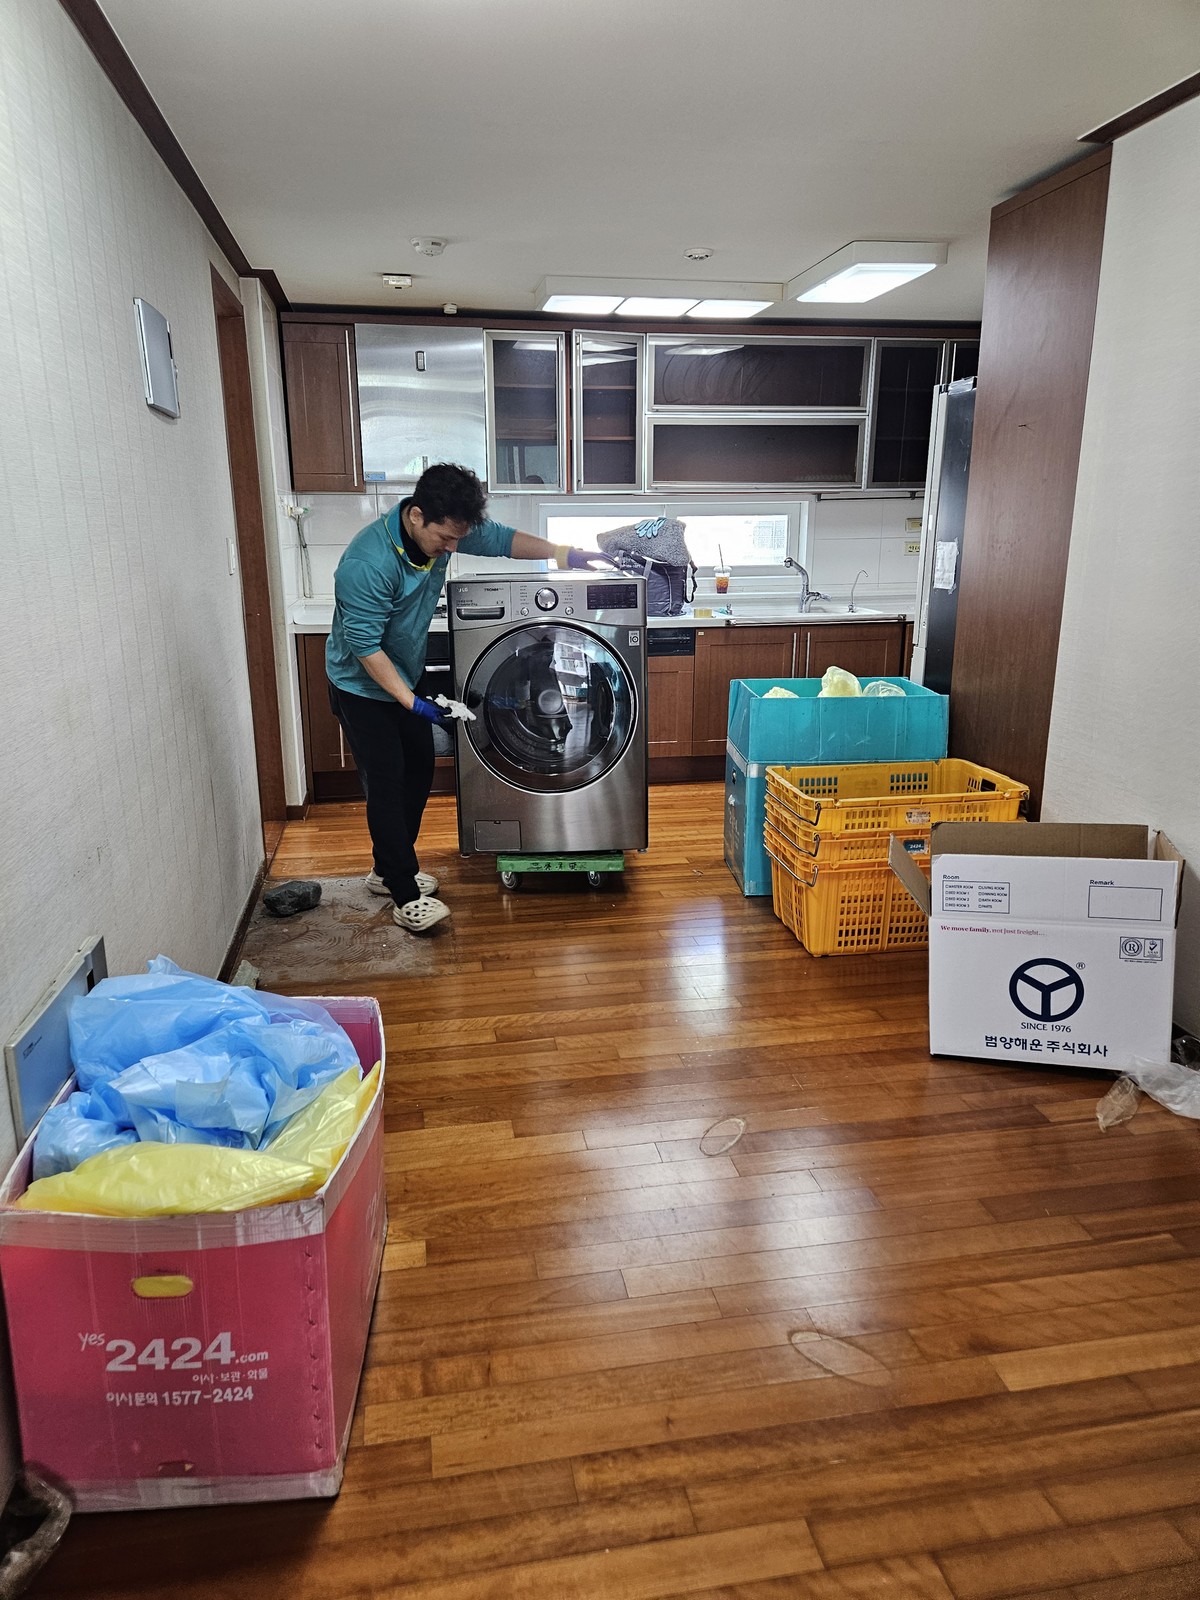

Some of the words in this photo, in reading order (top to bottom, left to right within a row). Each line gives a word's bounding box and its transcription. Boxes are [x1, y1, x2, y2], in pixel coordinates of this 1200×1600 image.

[1020, 1022, 1048, 1031] SINCE
[1050, 1024, 1072, 1033] 1976
[162, 1386, 254, 1406] 1577-2424
